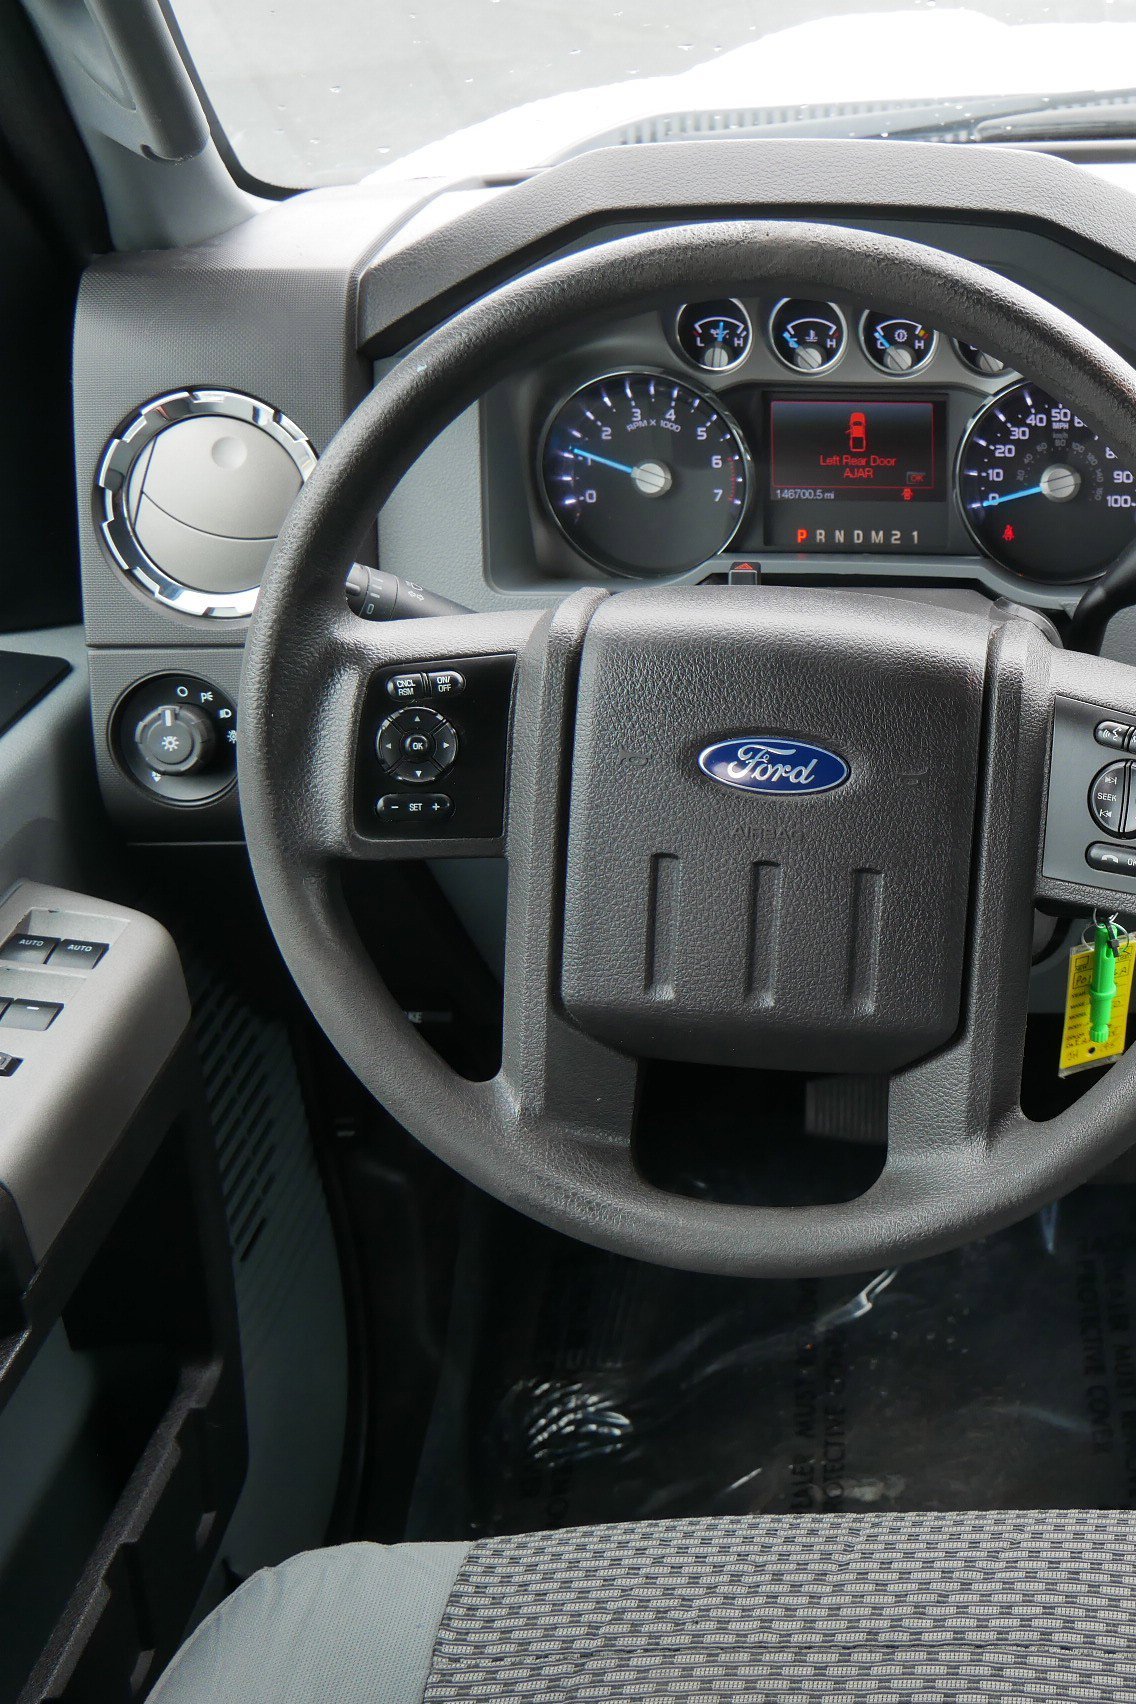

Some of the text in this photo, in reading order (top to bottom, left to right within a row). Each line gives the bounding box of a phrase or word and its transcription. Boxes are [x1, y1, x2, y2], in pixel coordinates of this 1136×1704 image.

[696, 337, 705, 347] L
[734, 337, 743, 347] H
[827, 339, 836, 348] H
[915, 340, 924, 350] H
[631, 409, 642, 422] 3
[665, 409, 677, 421] 4
[1026, 414, 1047, 427] 40
[1051, 408, 1071, 421] 50
[626, 420, 648, 432] RPM
[660, 420, 682, 433] 1000
[1052, 422, 1069, 430] MPH
[601, 427, 612, 440] 2
[697, 427, 707, 440] 5
[1010, 427, 1030, 440] 30
[994, 444, 1016, 457] 20
[711, 455, 722, 468] 6
[820, 455, 896, 467] Left Rear Door
[843, 468, 874, 479] AJAR
[988, 469, 1004, 481] 10
[1113, 470, 1134, 483] 90
[585, 490, 597, 503] 0
[713, 489, 723, 502] 7
[1106, 495, 1131, 508] 100
[797, 528, 919, 544] P R N D M 2 1
[398, 688, 414, 696] RSM
[438, 684, 451, 692] OFF
[413, 742, 424, 750] OK
[727, 744, 818, 785] Ford
[1097, 792, 1117, 802] SEEK
[409, 803, 423, 811] SET
[19, 938, 44, 947] AUTO
[68, 944, 93, 952] AUTO
